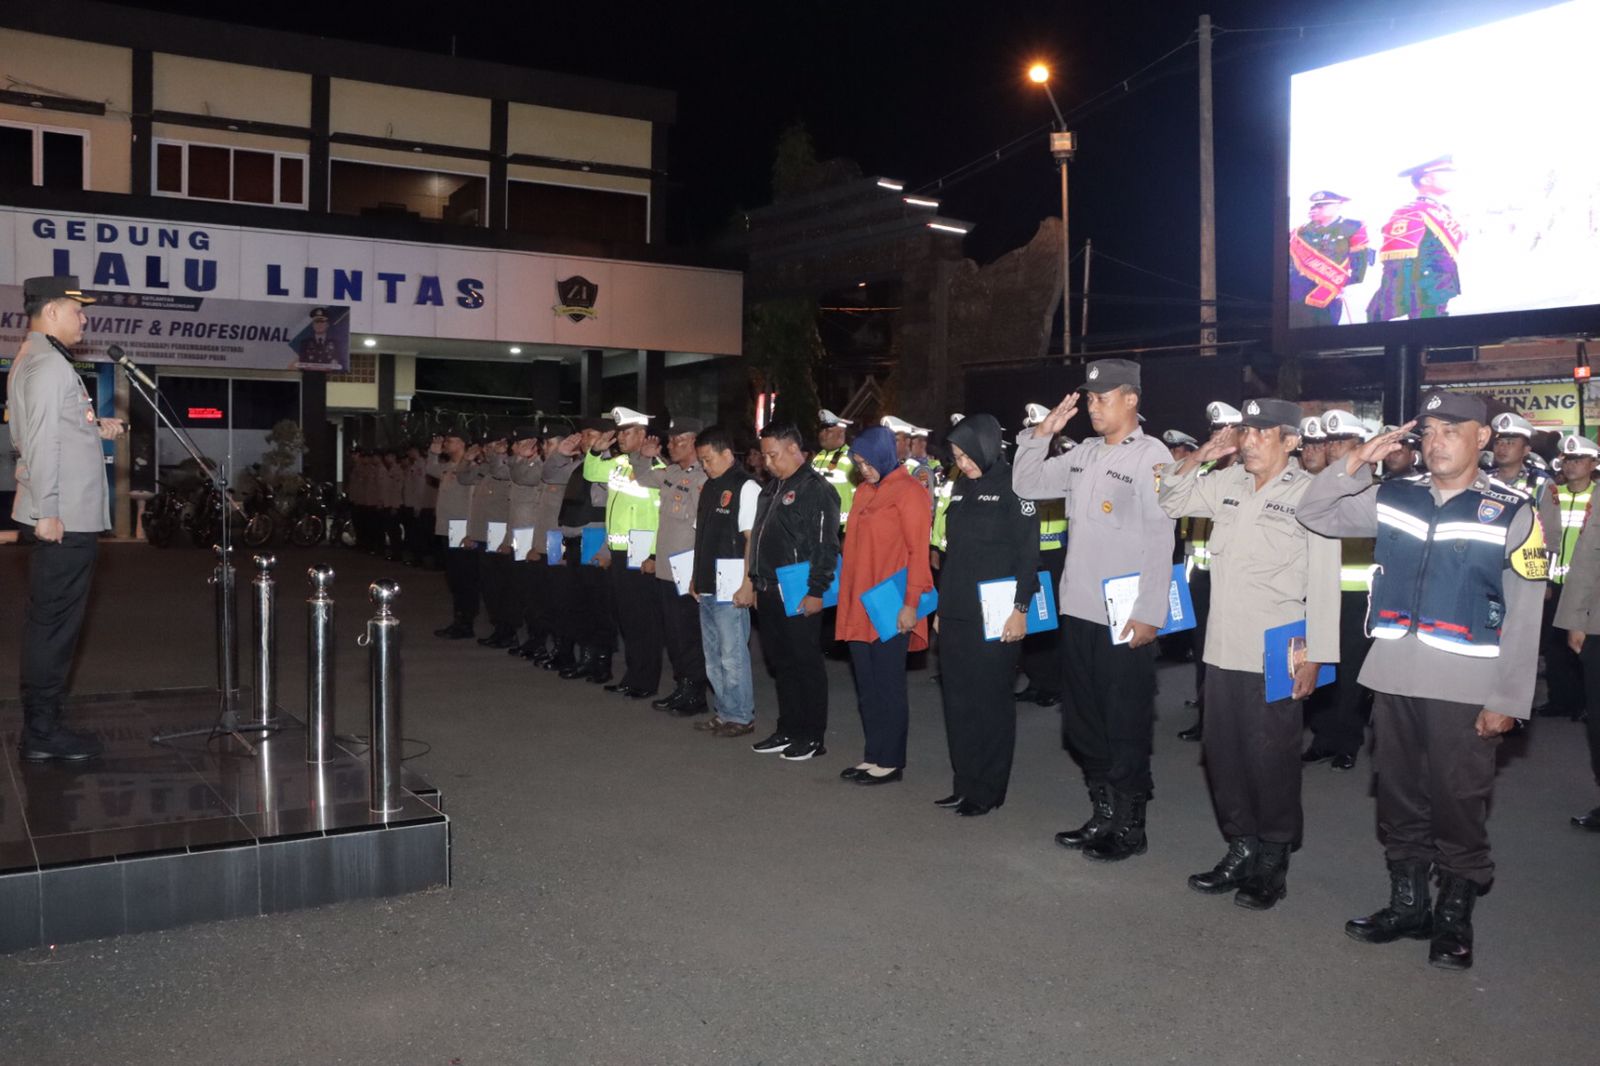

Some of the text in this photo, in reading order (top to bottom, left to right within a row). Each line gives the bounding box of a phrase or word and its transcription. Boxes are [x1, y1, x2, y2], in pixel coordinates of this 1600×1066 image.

[32, 218, 211, 251] GEDUNG
[53, 249, 484, 309] LALU LINTAS
[149, 320, 162, 335] &
[169, 321, 291, 343] PROFESIONAL
[1106, 470, 1133, 484] POLISI
[977, 494, 1000, 502] POLRI
[1265, 502, 1296, 515] POLIS
